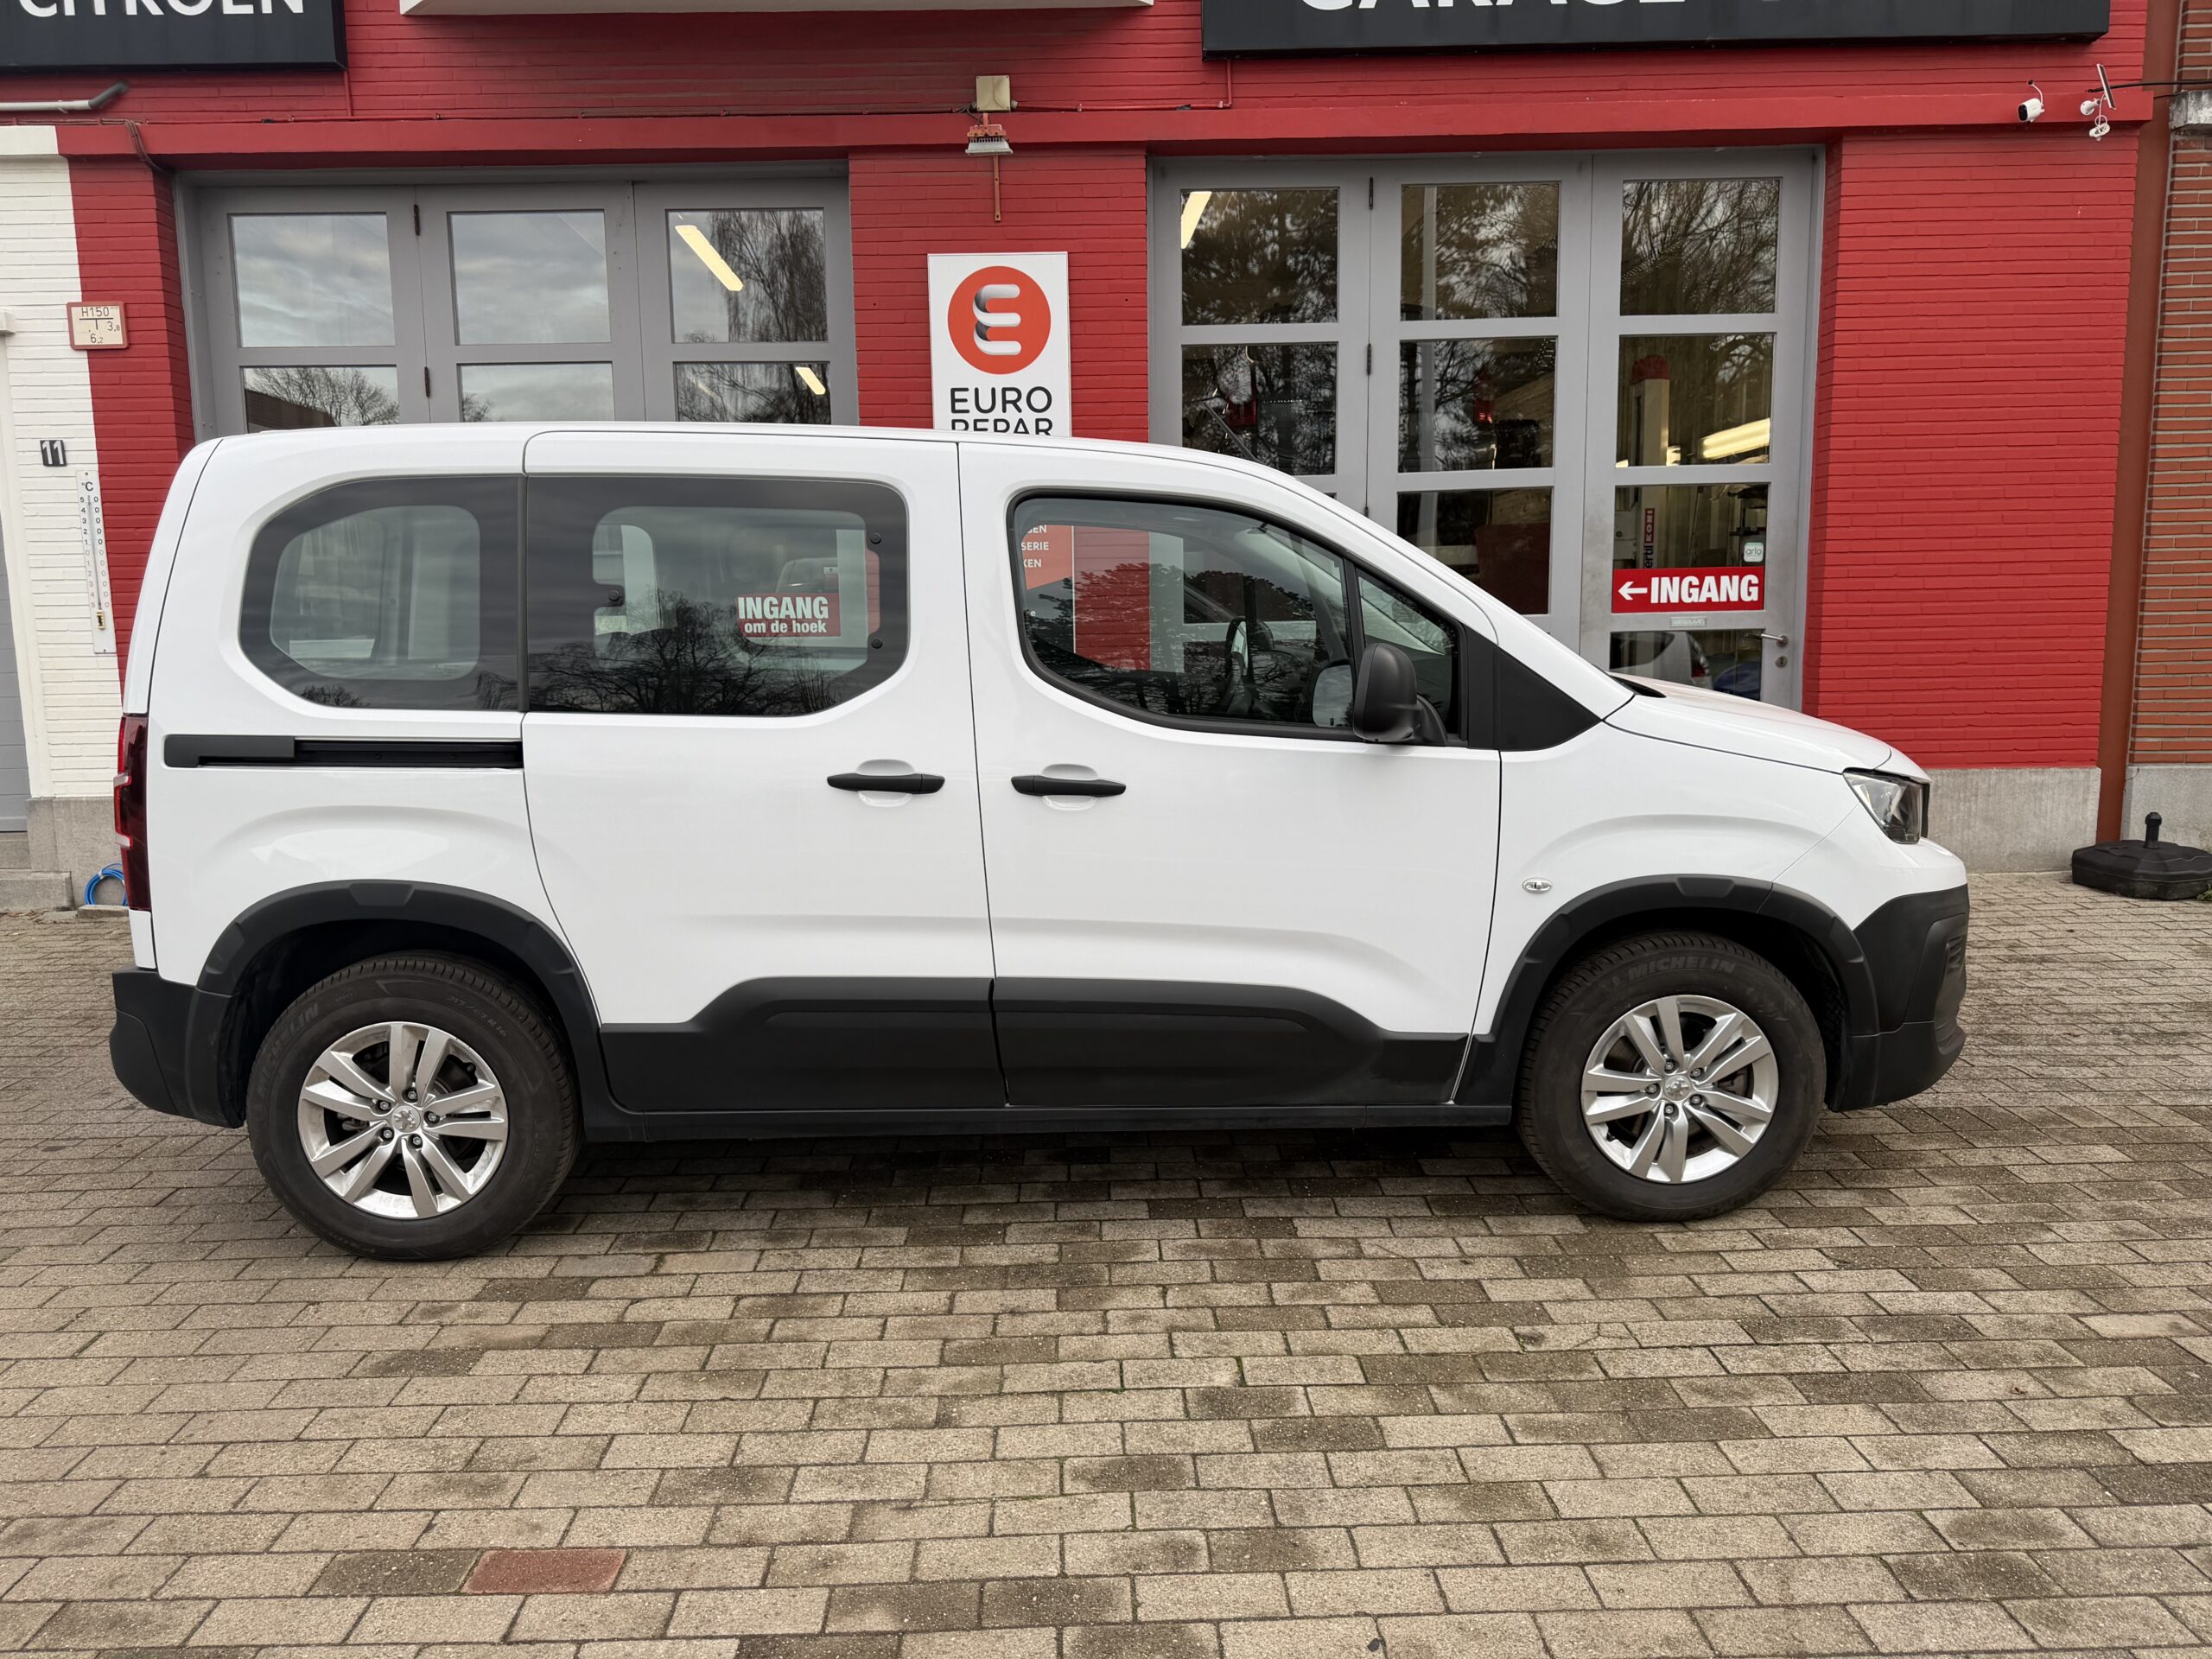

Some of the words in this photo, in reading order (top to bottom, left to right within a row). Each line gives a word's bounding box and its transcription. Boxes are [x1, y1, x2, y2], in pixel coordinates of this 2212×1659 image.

[81, 306, 110, 317] H150
[950, 386, 1052, 414] EURO
[42, 441, 64, 465] 11
[1650, 574, 1759, 604] INGANG
[738, 596, 830, 620] INGANG
[745, 623, 766, 633] om
[771, 620, 788, 633] de
[792, 620, 827, 633] hoek
[1627, 955, 1737, 982] MICHELIN
